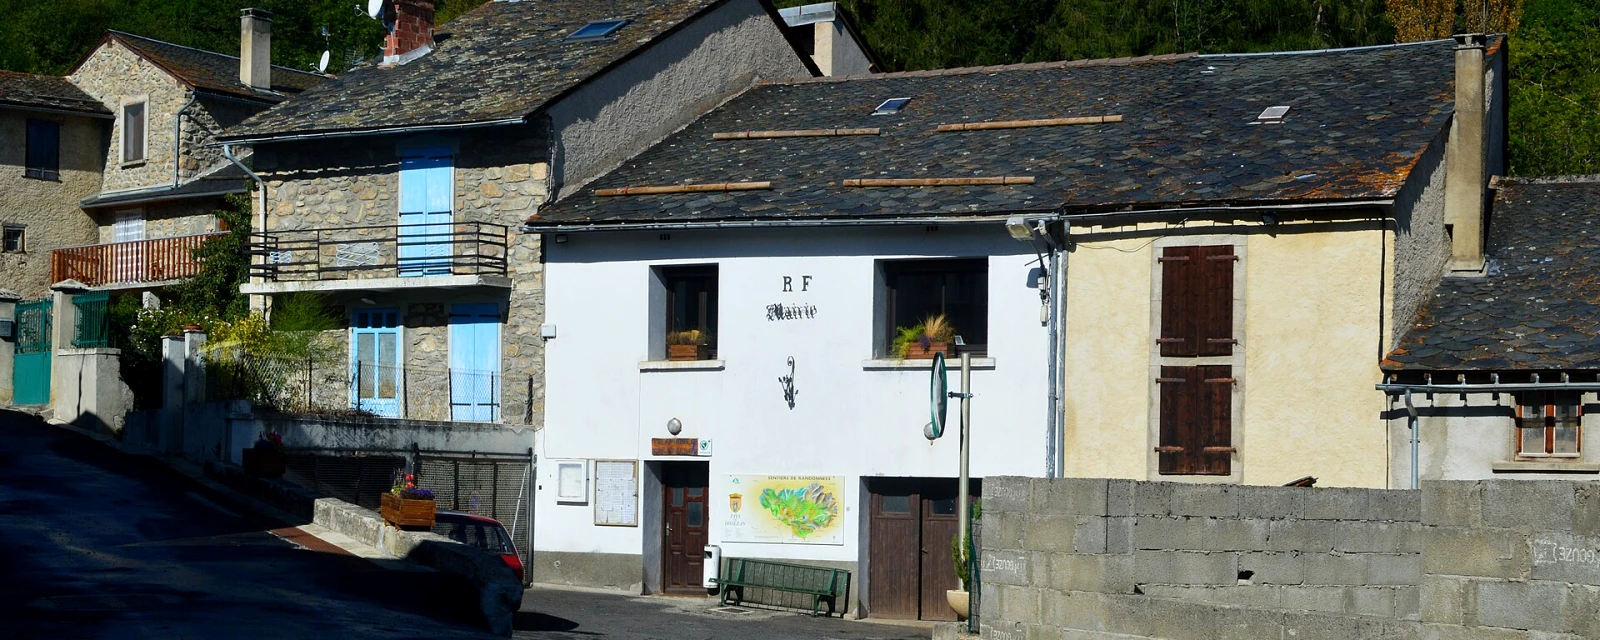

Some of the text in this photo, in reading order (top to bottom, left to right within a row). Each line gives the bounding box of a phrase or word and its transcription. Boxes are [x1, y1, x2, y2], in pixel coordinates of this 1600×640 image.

[782, 275, 813, 292] R F
[765, 302, 818, 322] Mairie
[1558, 546, 1595, 564] GOUZE
